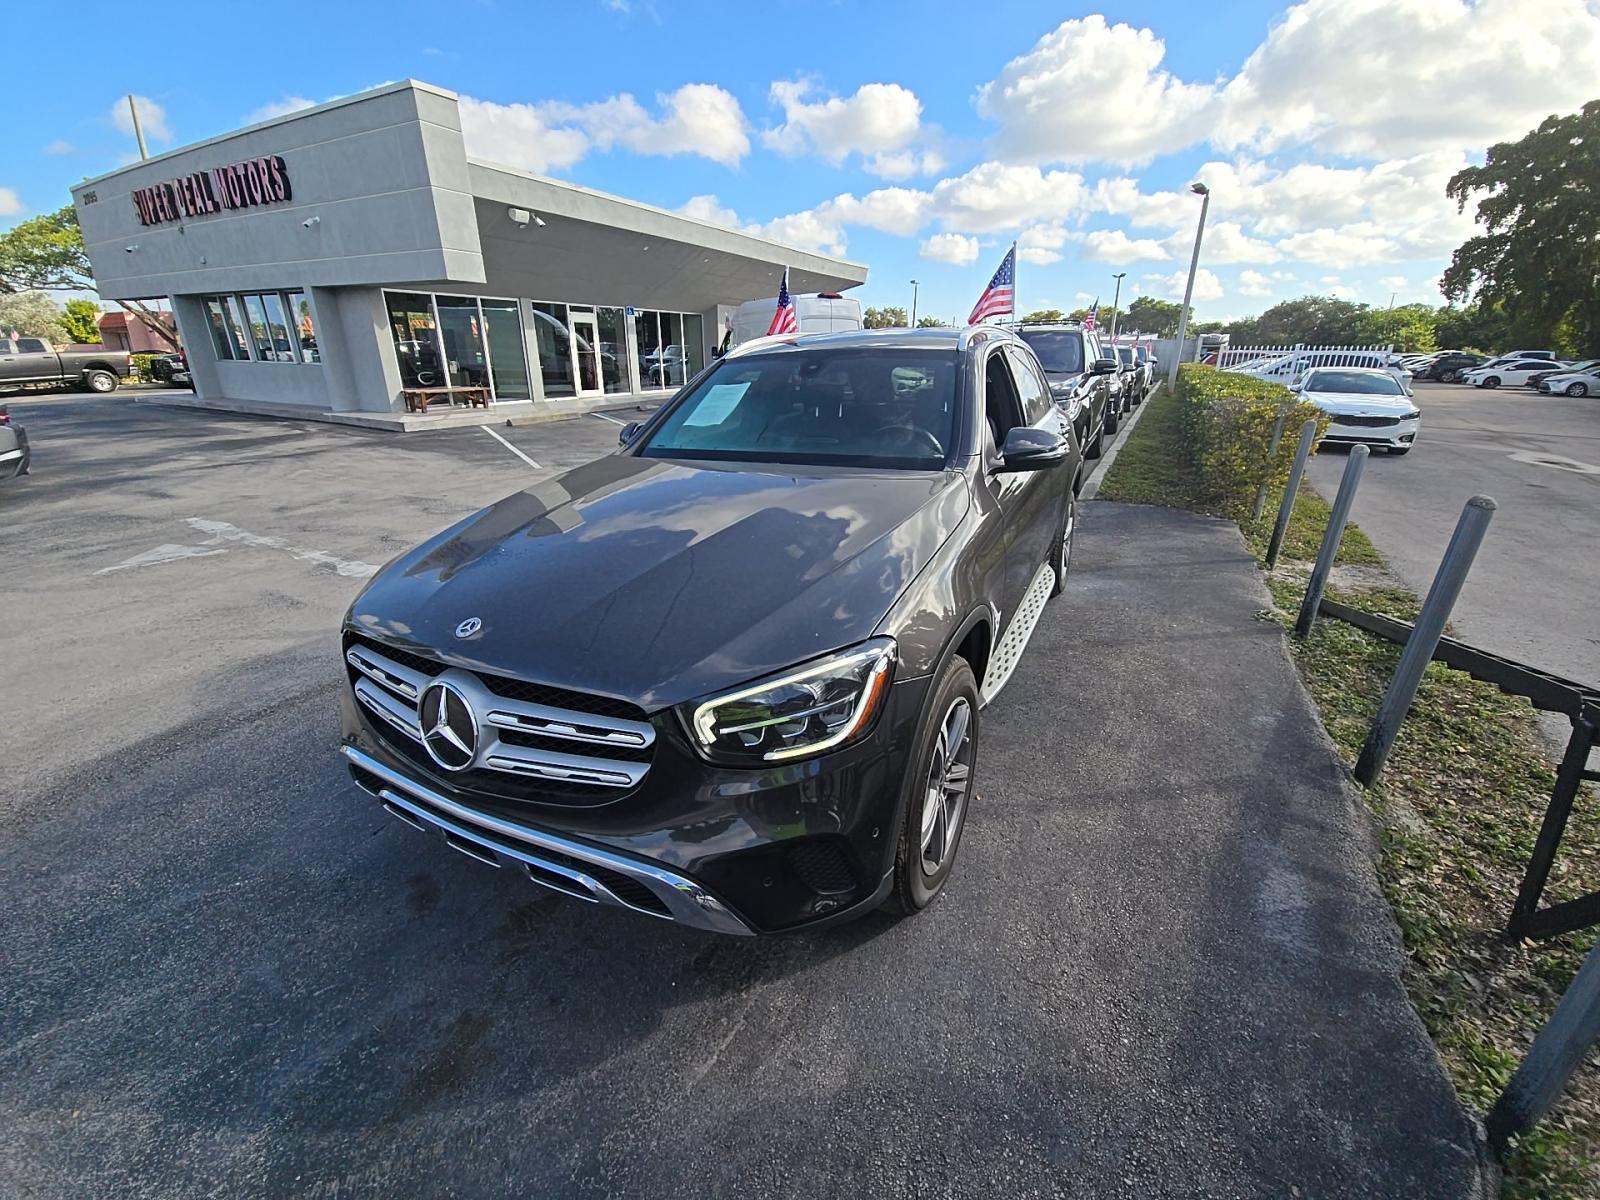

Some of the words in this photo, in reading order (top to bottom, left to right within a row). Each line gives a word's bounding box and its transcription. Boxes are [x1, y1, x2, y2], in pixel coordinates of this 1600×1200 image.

[132, 182, 180, 226] SUPER
[174, 171, 220, 217] DEAL
[213, 155, 292, 210] MOTORS
